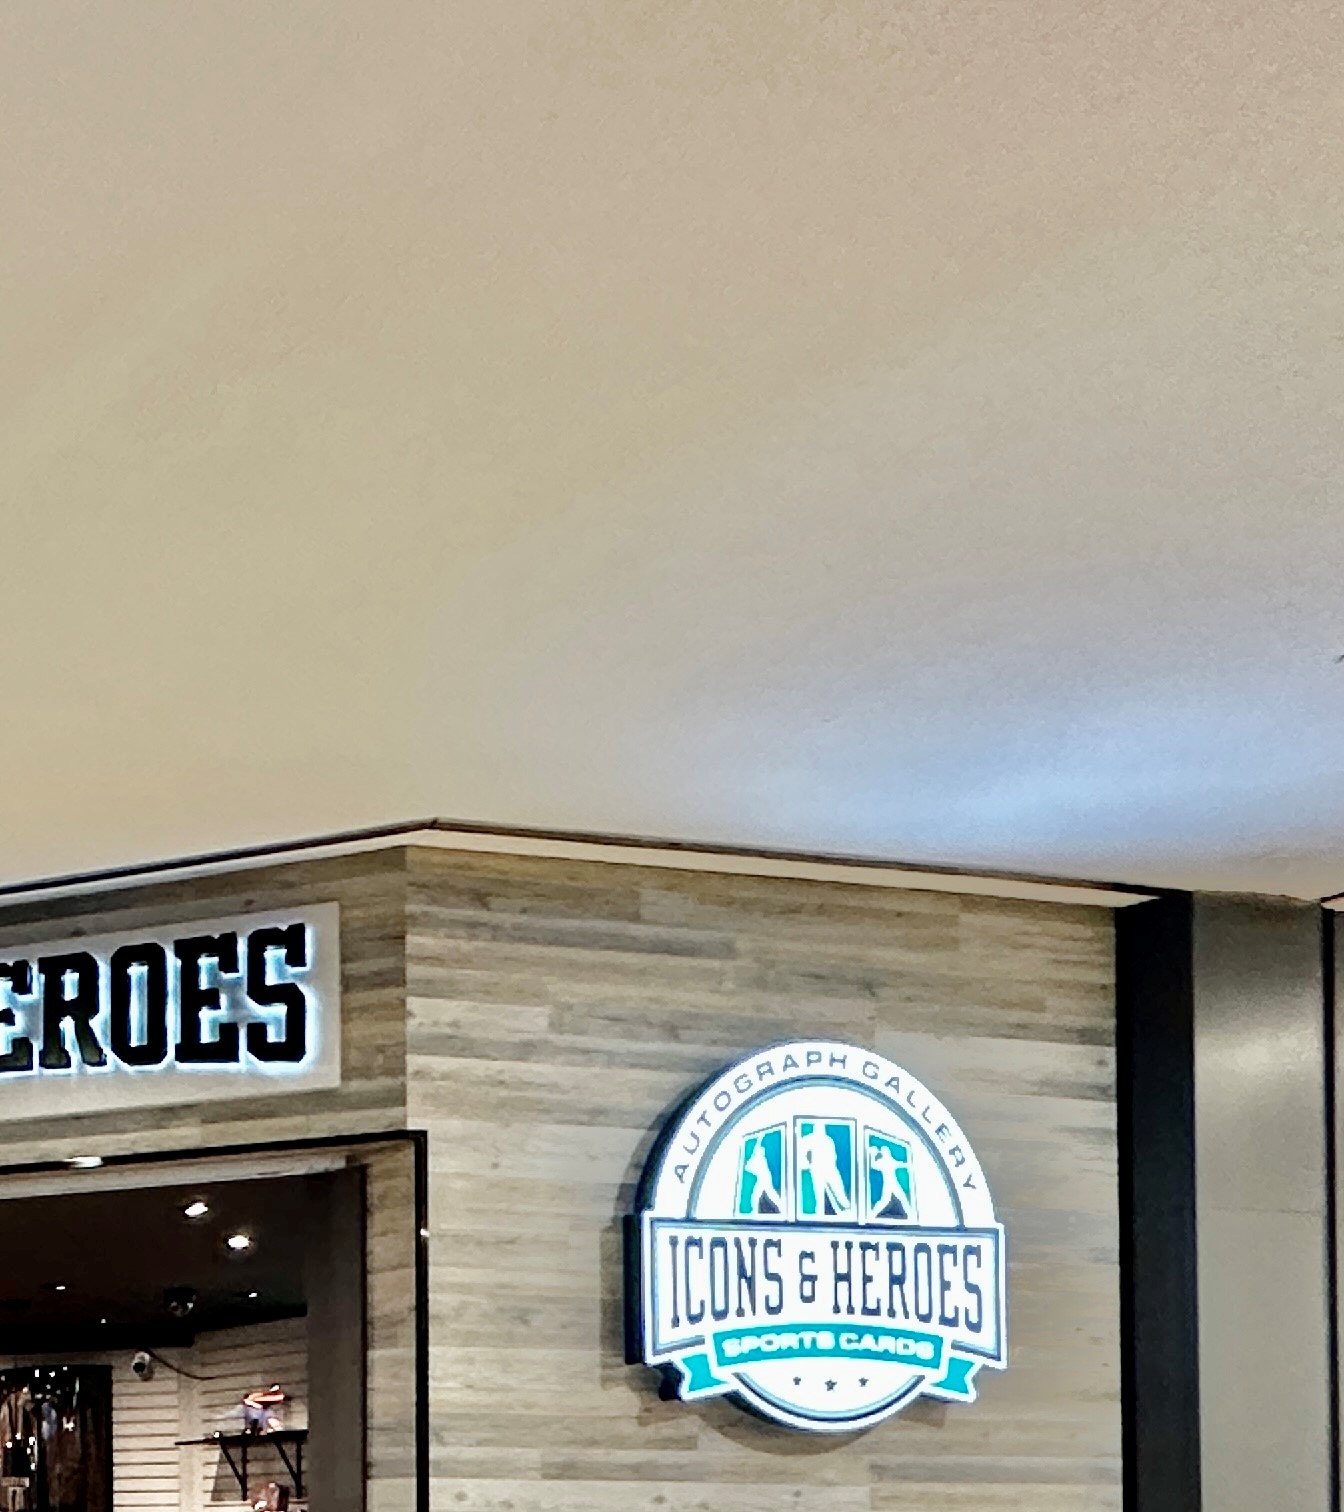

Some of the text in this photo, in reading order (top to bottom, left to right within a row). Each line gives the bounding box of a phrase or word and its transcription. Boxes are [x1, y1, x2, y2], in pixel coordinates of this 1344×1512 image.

[674, 1050, 977, 1190] AUTOGRAPH GALLERY
[668, 1236, 983, 1333] ICONS & HEROES
[721, 1330, 935, 1360] SPORTS CARDS
